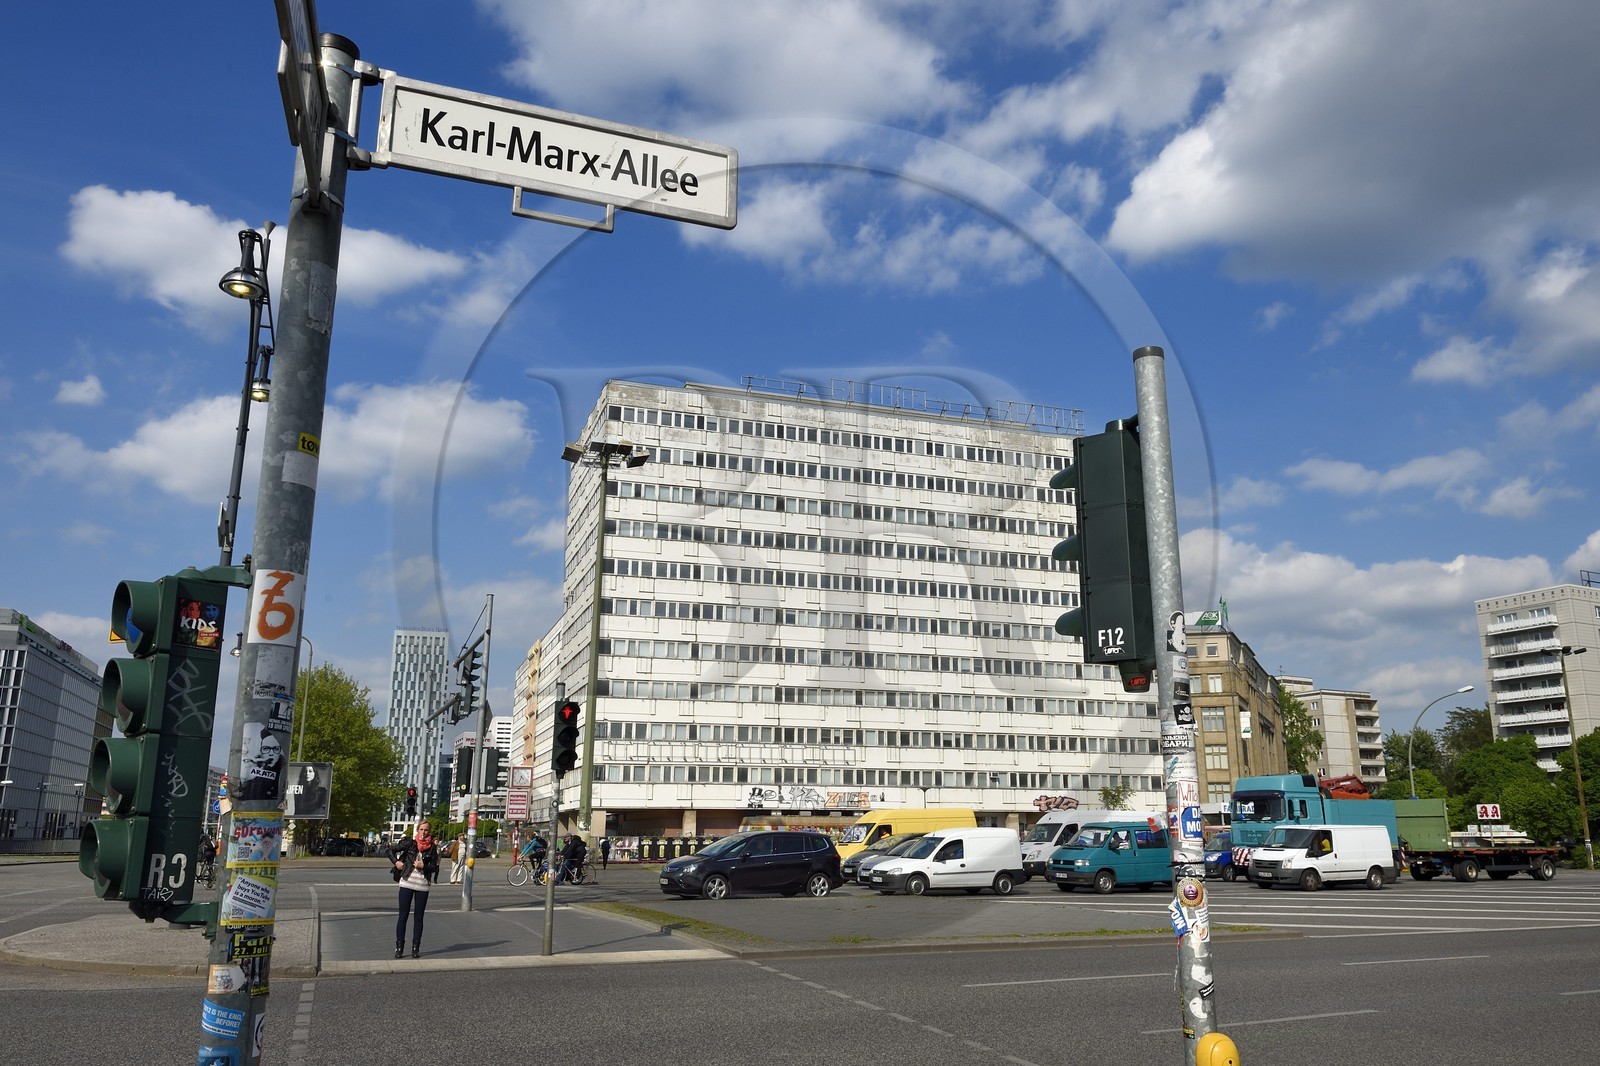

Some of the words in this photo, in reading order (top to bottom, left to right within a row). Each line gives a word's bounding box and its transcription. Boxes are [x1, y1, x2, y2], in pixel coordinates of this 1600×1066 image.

[419, 107, 699, 198] Karl-Marx-Allee
[1201, 611, 1218, 619] AOK
[180, 616, 216, 633] KIDS
[1098, 627, 1125, 647] F12
[250, 768, 276, 779] ARATA
[148, 853, 188, 889] R3
[237, 884, 250, 895] buys
[260, 885, 271, 895] who
[234, 947, 249, 955] 27.
[211, 1008, 217, 1016] IS
[217, 1010, 228, 1019] THE
